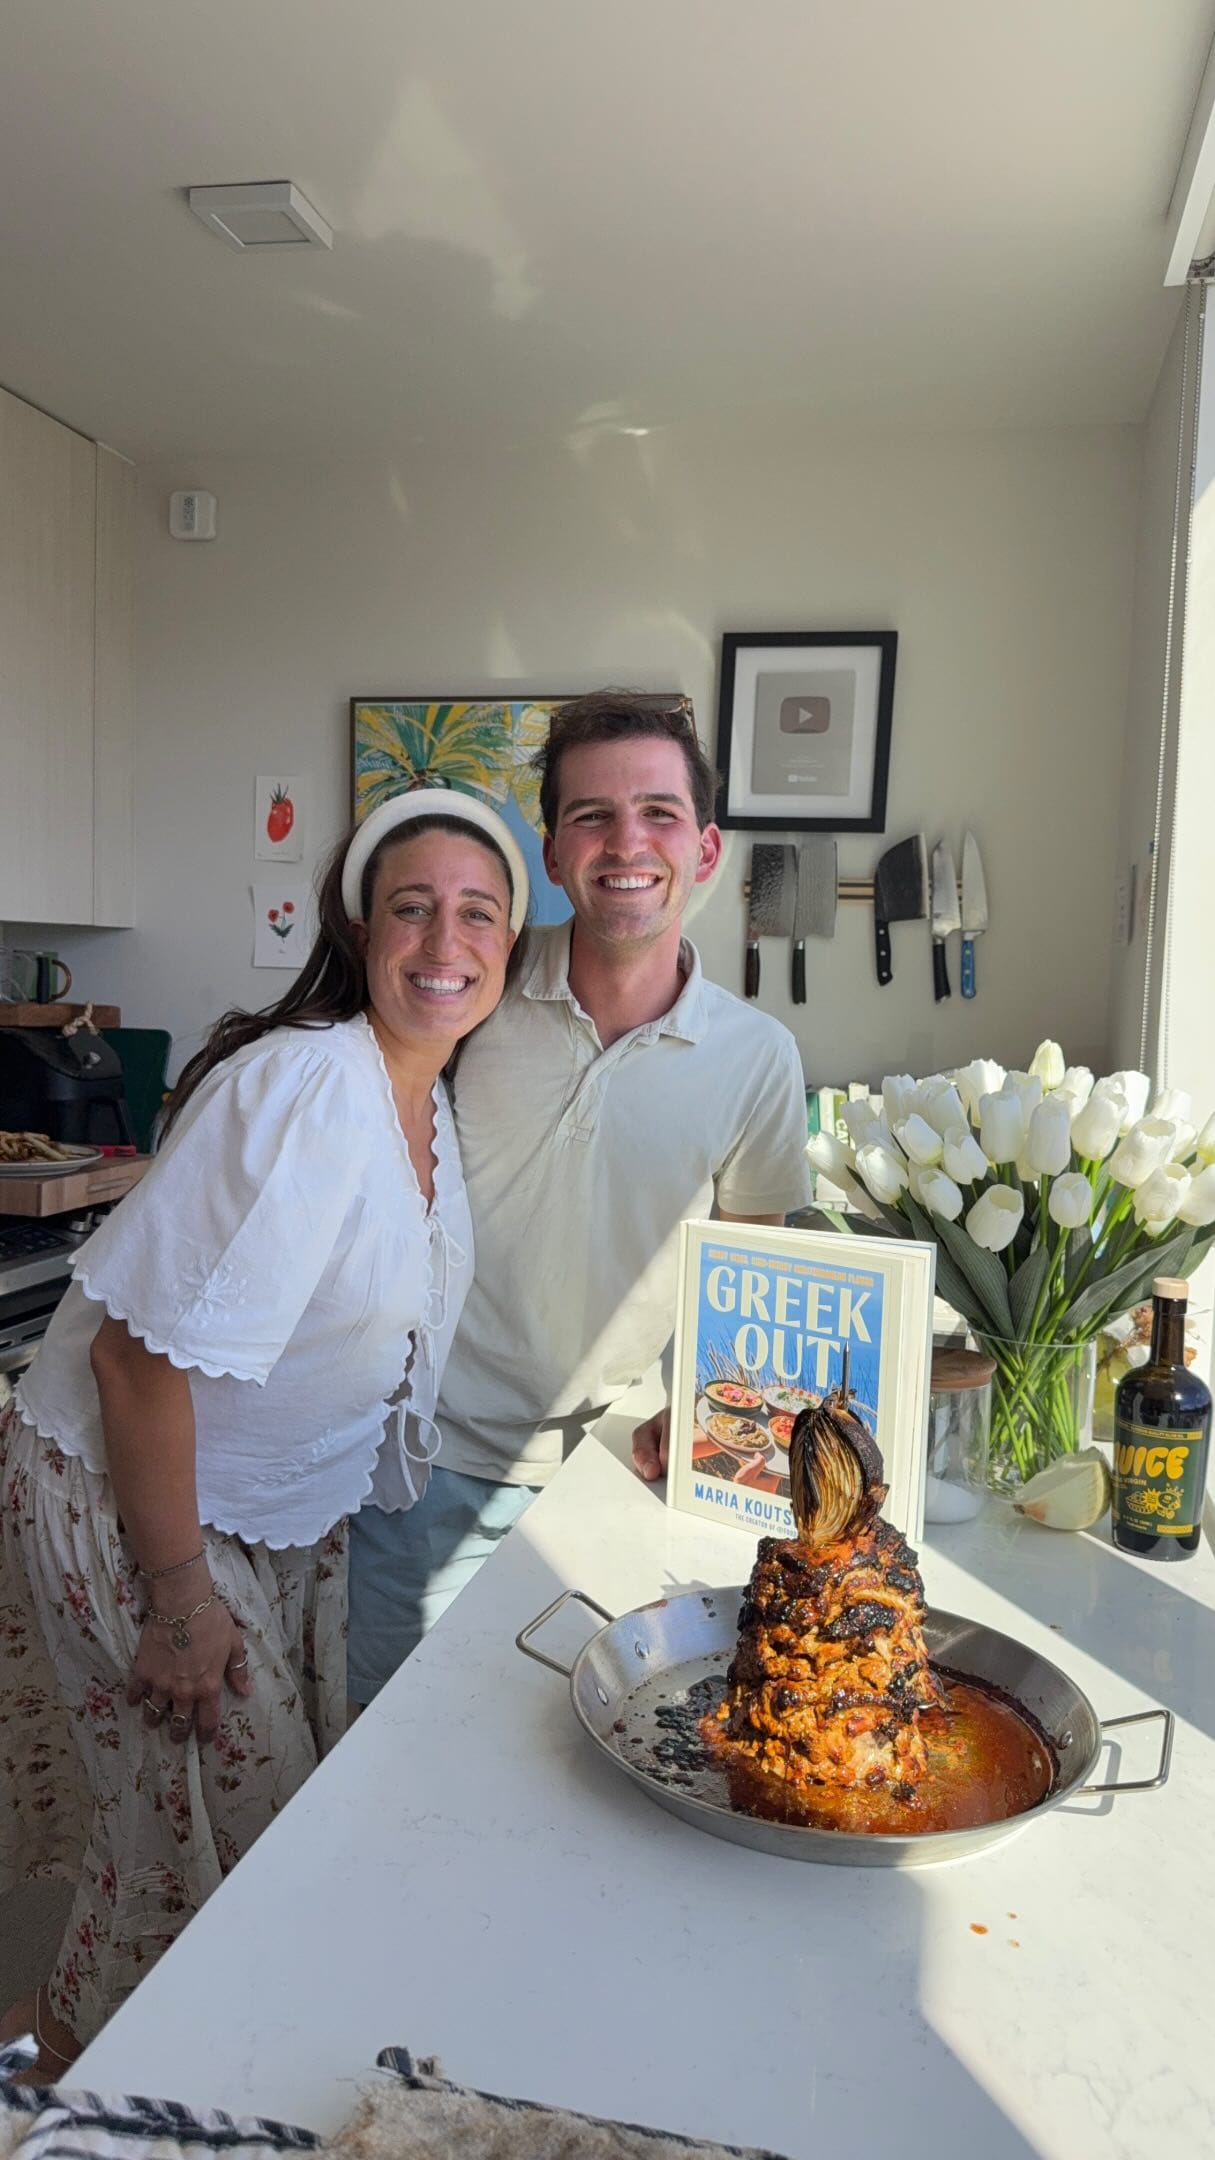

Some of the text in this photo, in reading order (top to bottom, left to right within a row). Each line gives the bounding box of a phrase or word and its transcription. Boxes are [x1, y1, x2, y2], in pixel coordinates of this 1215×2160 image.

[706, 1265, 873, 1344] GREEK
[734, 1322, 841, 1388] OUT
[694, 1482, 792, 1526] MARIA KOUTS
